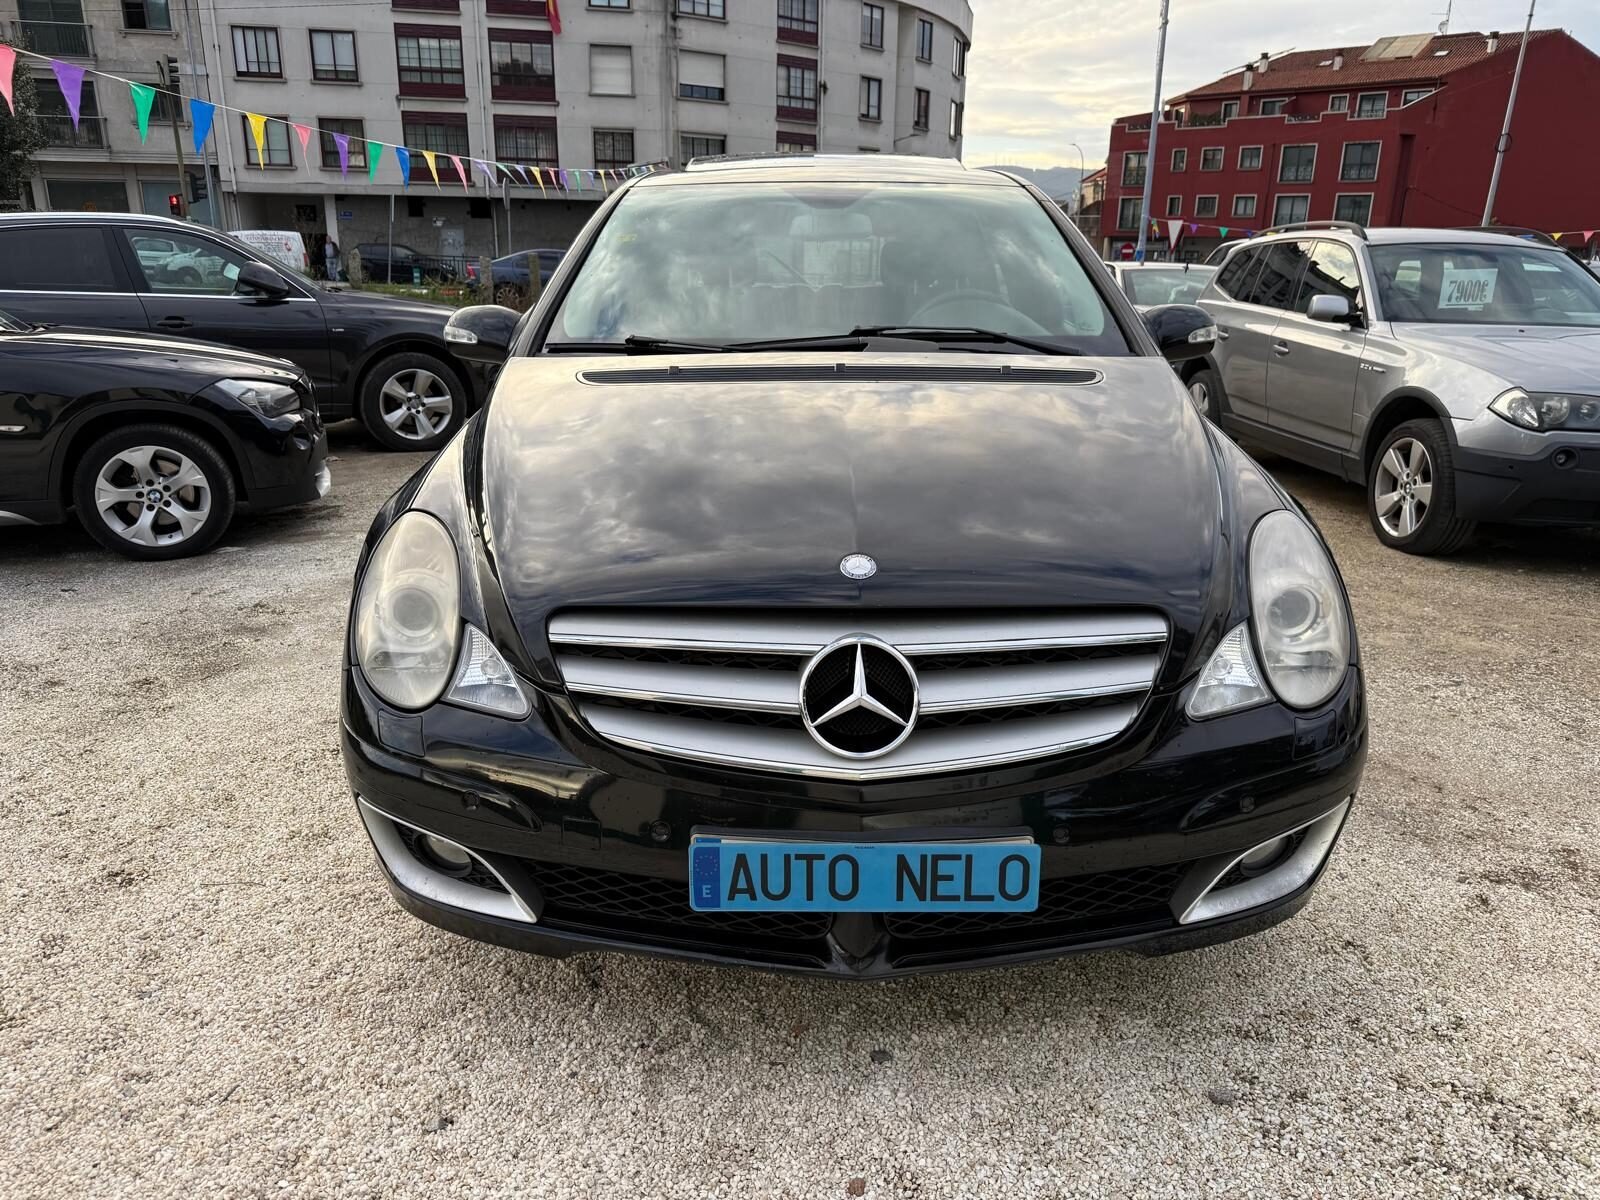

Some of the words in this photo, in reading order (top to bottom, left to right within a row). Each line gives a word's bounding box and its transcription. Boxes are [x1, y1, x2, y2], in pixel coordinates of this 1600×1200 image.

[1447, 280, 1489, 303] 7900€
[727, 853, 860, 902] AUTO
[896, 853, 1031, 902] NELO
[702, 884, 712, 898] E
